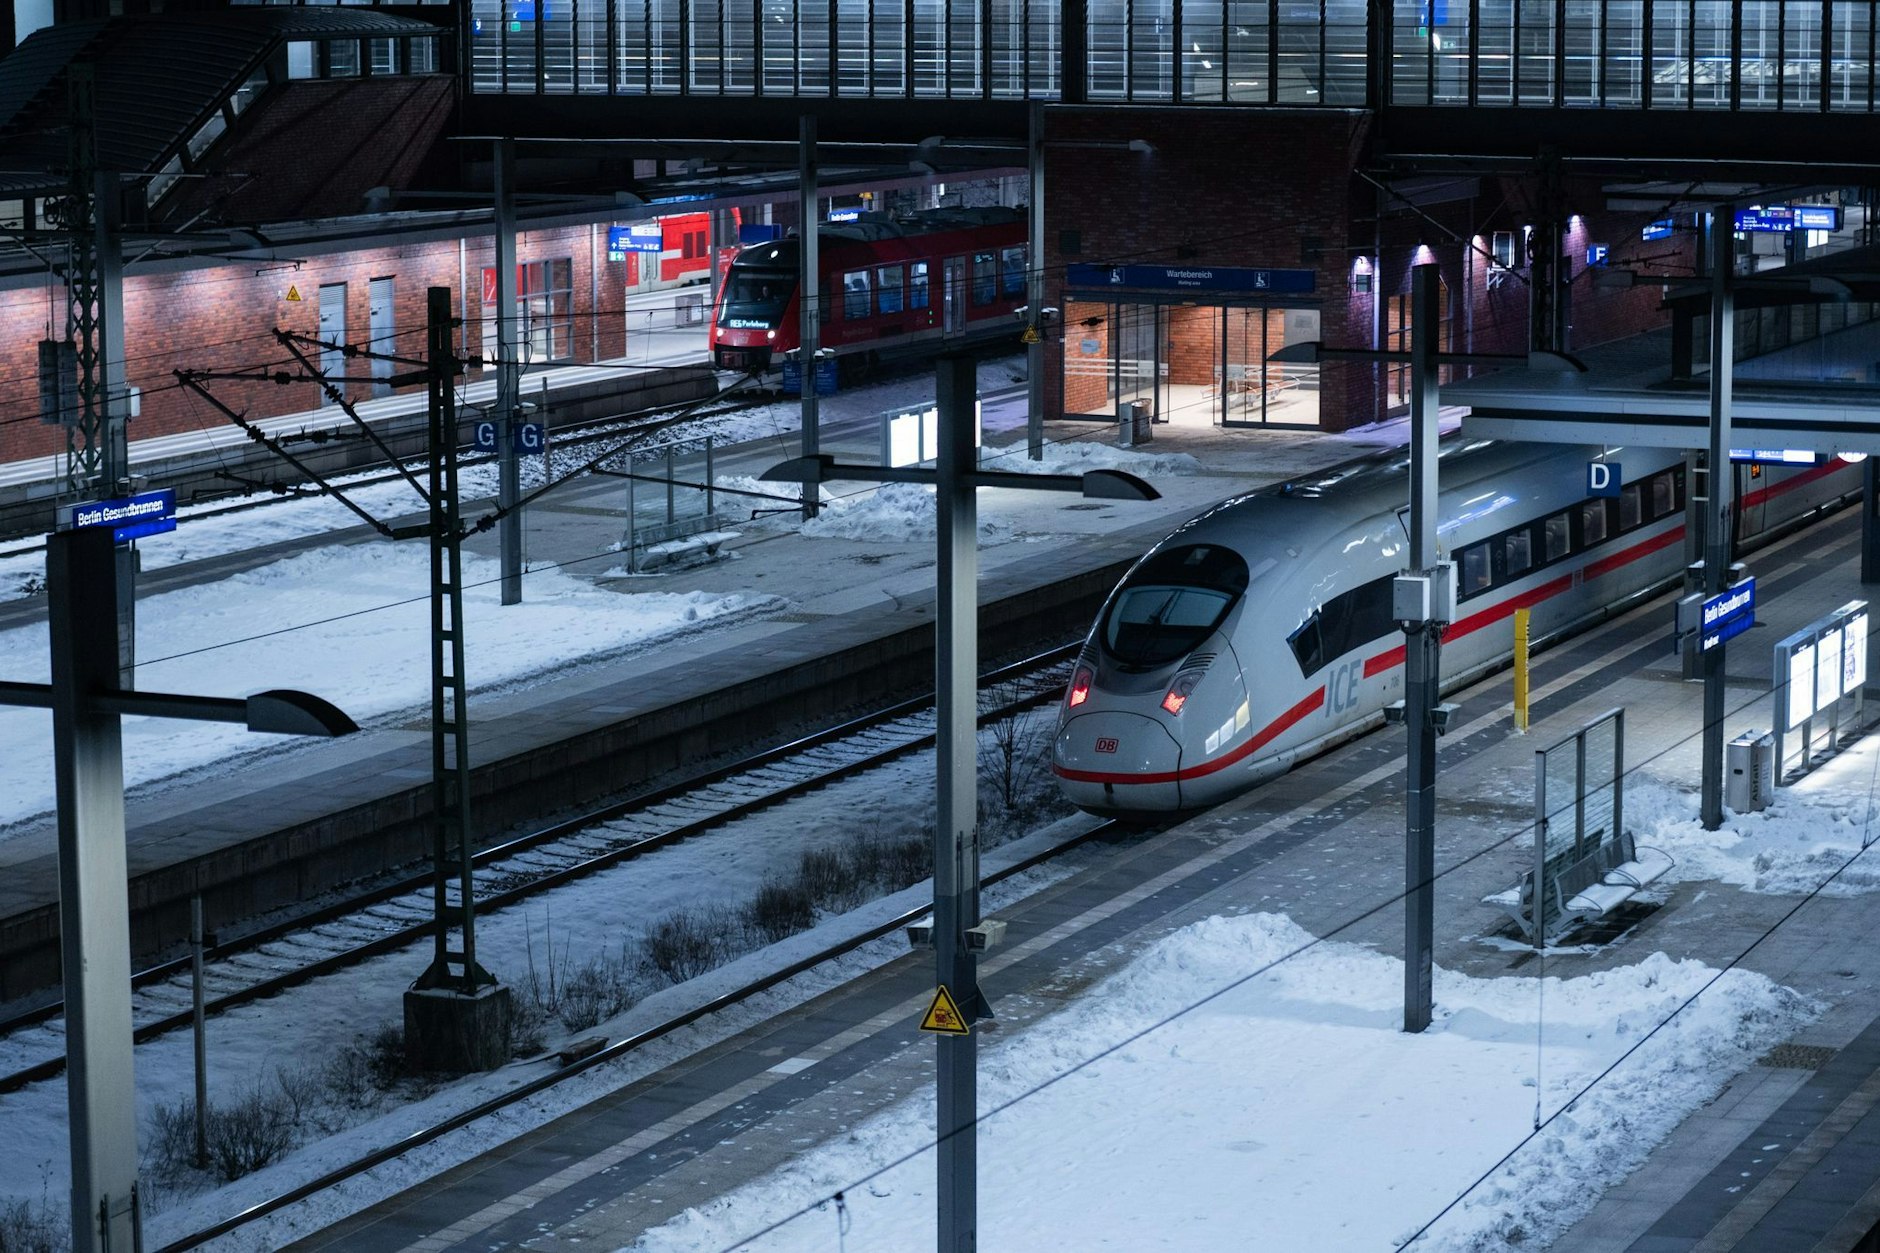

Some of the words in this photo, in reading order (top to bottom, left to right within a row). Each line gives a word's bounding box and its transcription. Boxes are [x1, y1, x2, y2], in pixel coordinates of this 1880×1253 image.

[1596, 247, 1606, 261] F
[1166, 270, 1213, 279] Wartebereich
[478, 423, 494, 446] G
[521, 424, 538, 447] G
[1591, 463, 1610, 489] D
[78, 510, 102, 527] Berlin
[102, 500, 164, 521] Gesundbrunnen
[1704, 605, 1718, 625] Berlin
[1718, 589, 1751, 618] Gesundbrunnen
[1325, 658, 1362, 718] ICE
[1098, 740, 1115, 751] DB
